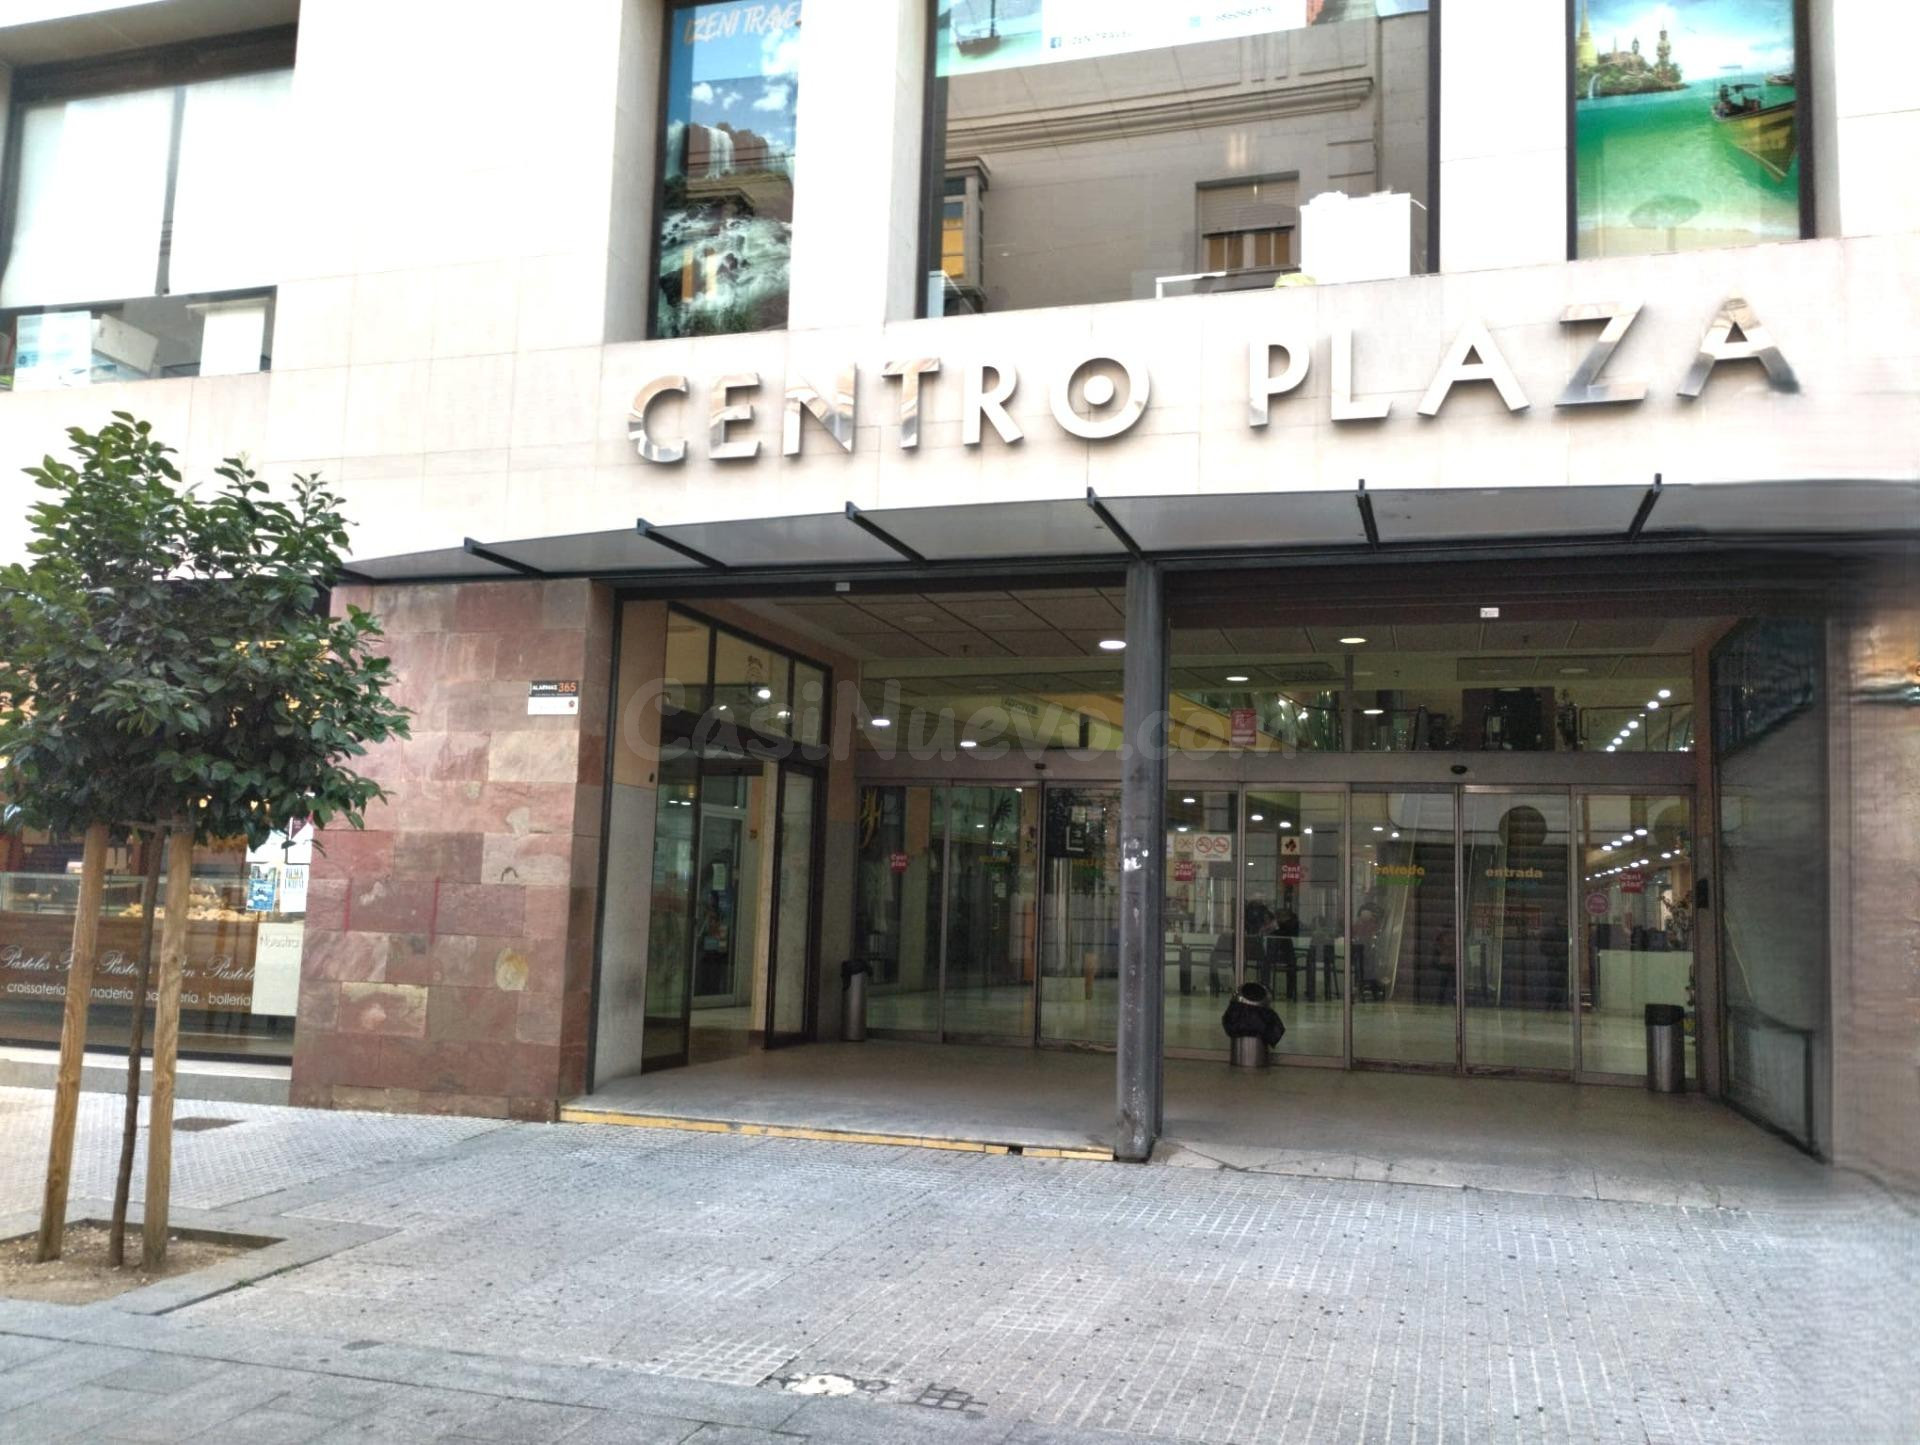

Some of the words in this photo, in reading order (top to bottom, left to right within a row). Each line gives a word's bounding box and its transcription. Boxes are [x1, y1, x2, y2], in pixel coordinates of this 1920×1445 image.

[627, 355, 1152, 464] CENTRO
[1248, 288, 1802, 429] PLAZA
[558, 682, 577, 693] 365
[1375, 864, 1425, 877] entrada
[1485, 867, 1543, 878] entrada
[1, 945, 50, 971] Pasteles
[208, 991, 252, 1007] bollería
